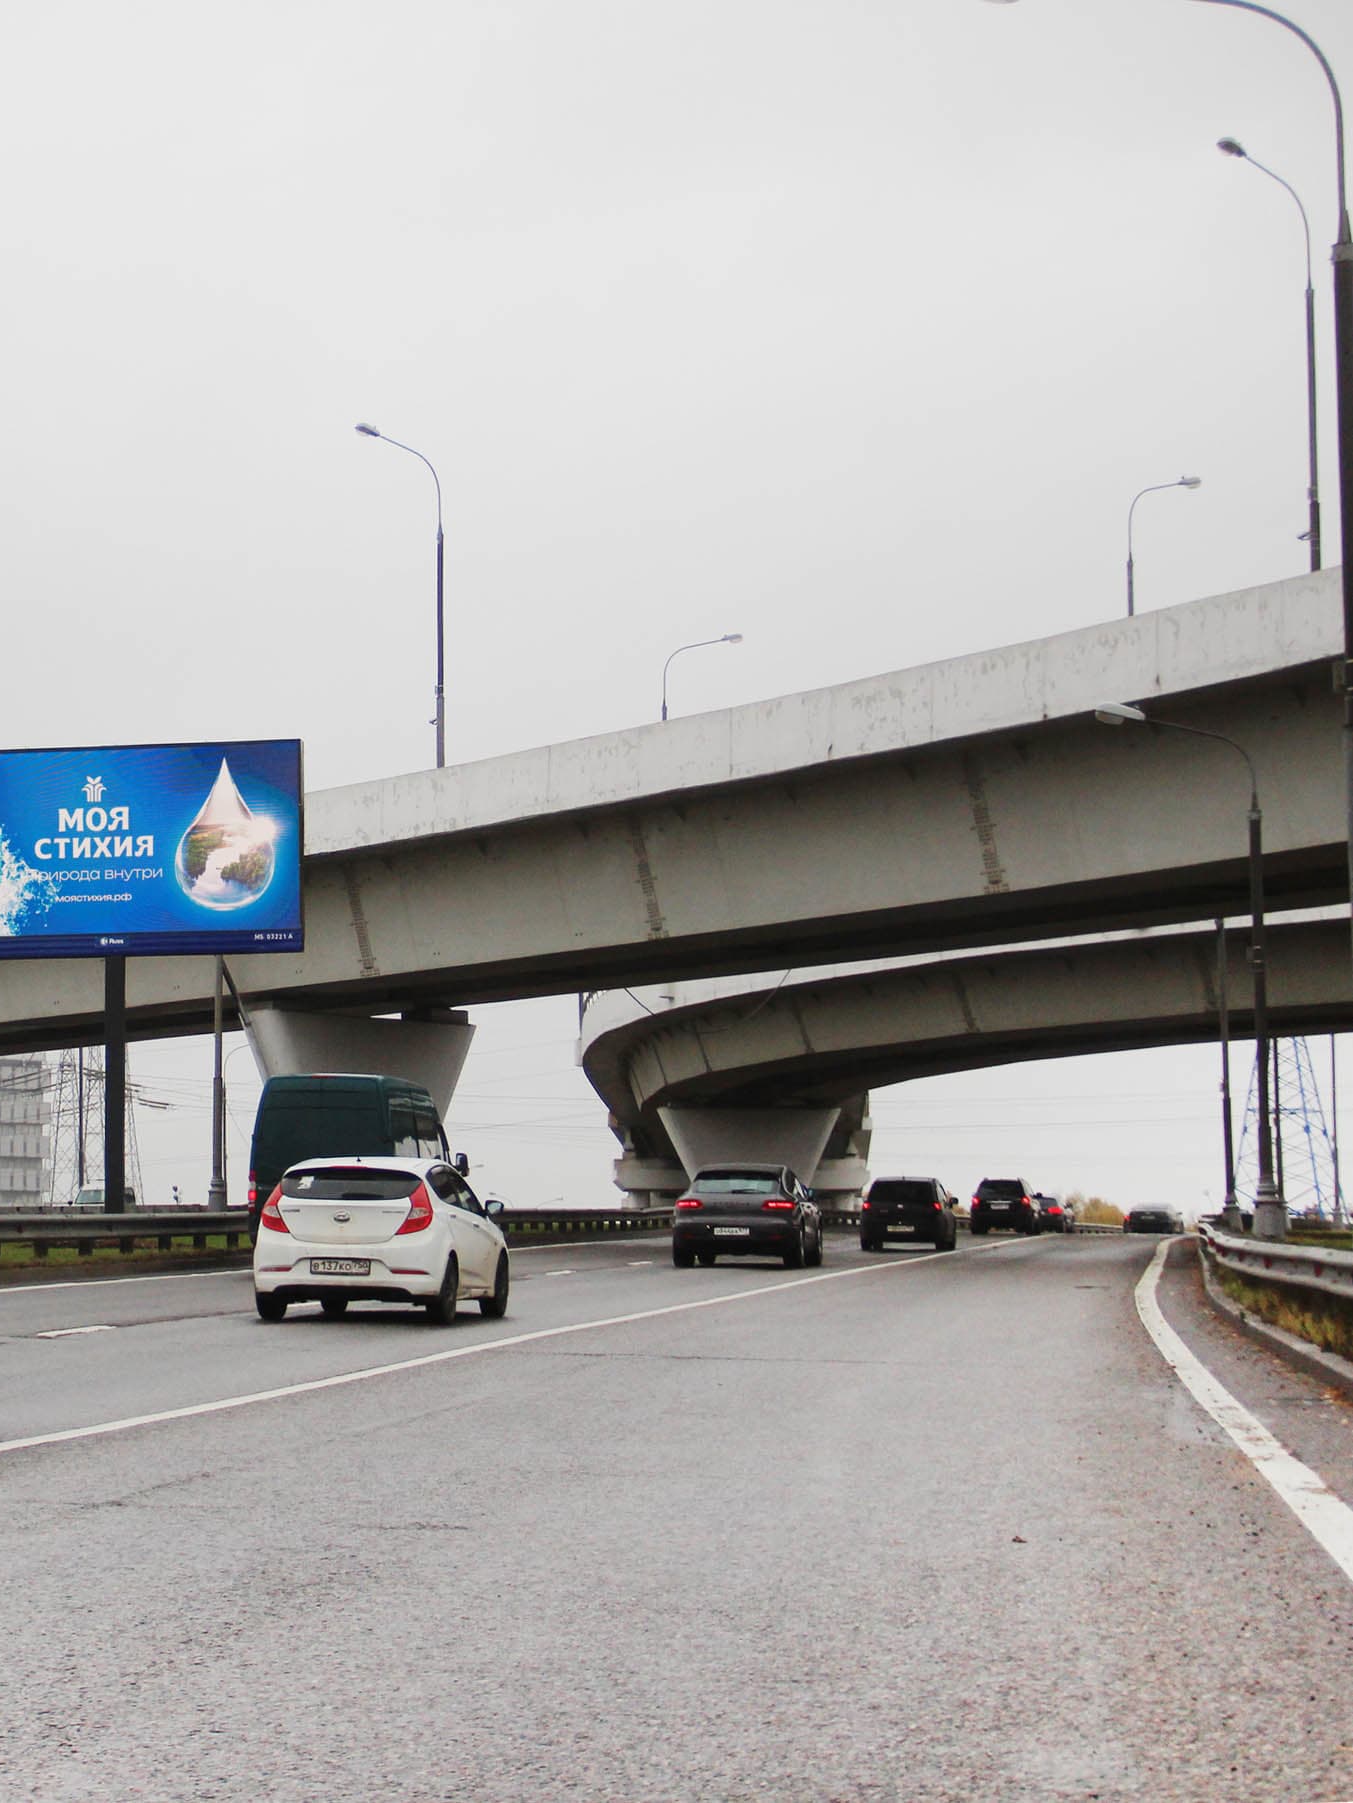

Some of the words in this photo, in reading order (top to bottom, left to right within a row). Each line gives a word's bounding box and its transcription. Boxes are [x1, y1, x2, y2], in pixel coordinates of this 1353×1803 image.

[57, 806, 131, 833] МОЯ
[33, 834, 155, 860] СТИХИЯ
[104, 867, 164, 882] внутри
[55, 891, 133, 904] моястихия.рф
